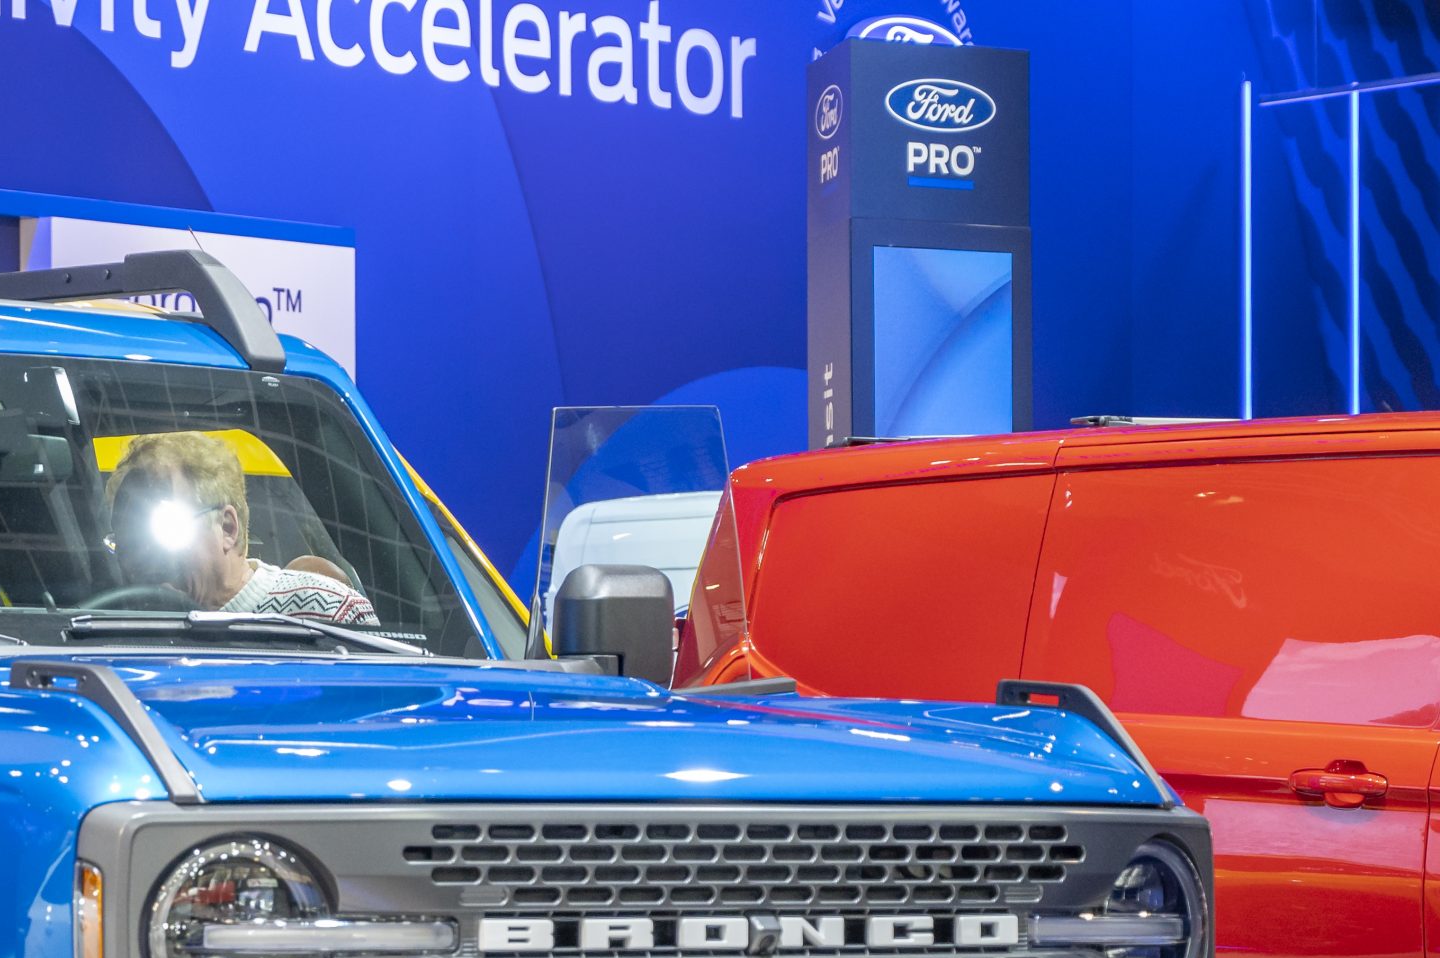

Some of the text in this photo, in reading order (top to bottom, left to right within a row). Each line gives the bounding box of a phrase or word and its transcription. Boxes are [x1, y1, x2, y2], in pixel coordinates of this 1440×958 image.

[821, 93, 838, 131] Ford
[907, 85, 976, 124] Ford
[357, 631, 427, 640] RONCO
[478, 915, 1019, 952] BRONCO
